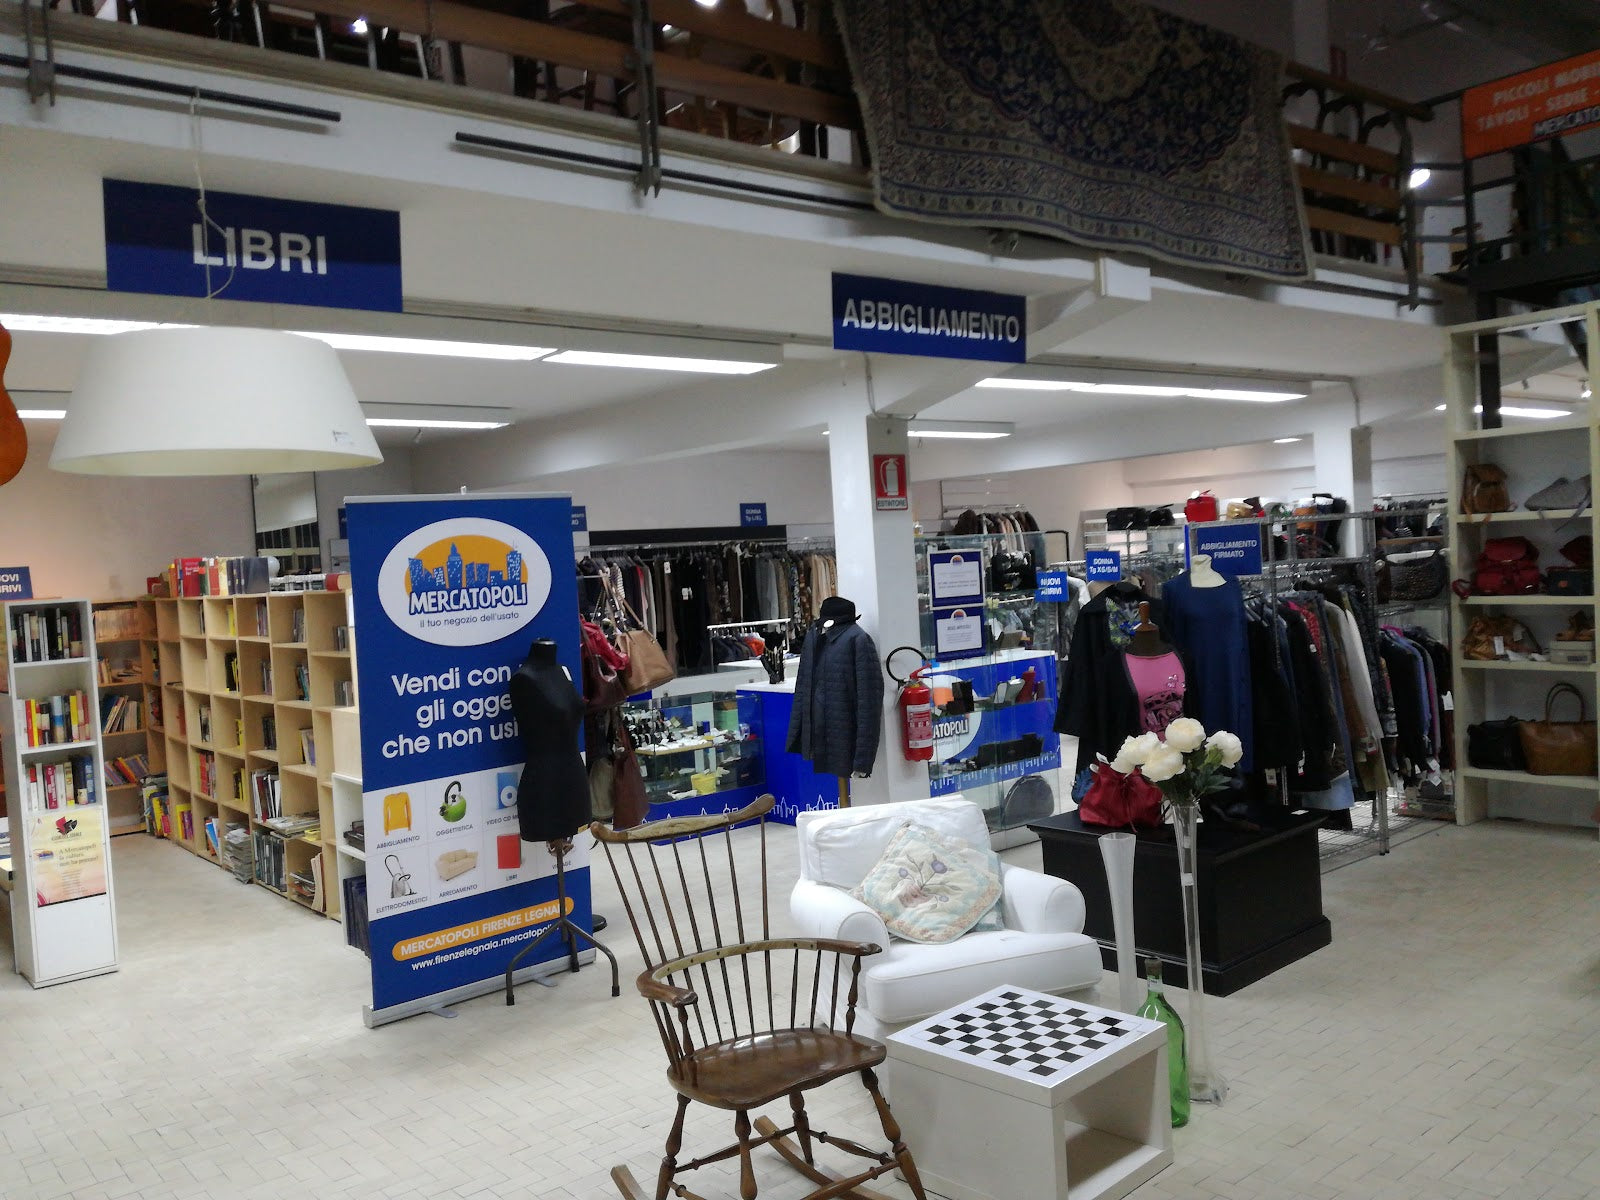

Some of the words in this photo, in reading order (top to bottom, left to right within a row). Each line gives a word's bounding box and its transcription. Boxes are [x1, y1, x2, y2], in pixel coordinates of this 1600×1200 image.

[1477, 104, 1529, 132] TAVOLI
[192, 223, 327, 275] LIBRI
[842, 298, 1020, 343] ABBIGLIAMENTO
[1201, 540, 1258, 550] ABBIGLIAMENTO
[1214, 550, 1244, 558] FIRMATO
[0, 573, 20, 583] OVI
[1041, 578, 1060, 586] NUOVI
[410, 583, 528, 615] MERCATOPOLI
[427, 618, 441, 628] tuo
[444, 615, 478, 626] negozio
[480, 611, 520, 624] dell'usato
[391, 667, 460, 696] Vendi
[467, 665, 511, 687] con
[416, 699, 445, 728] gli
[382, 734, 430, 758] che
[438, 726, 482, 749] non
[490, 717, 518, 741] usi
[487, 817, 502, 825] VIDEO
[376, 835, 420, 849] ABBIGLIAMENTO
[439, 884, 478, 898] ARREDAMENTO
[376, 896, 428, 913] ELETTRODOMESTICI
[401, 927, 479, 956] MERCATOPOLI
[482, 914, 522, 934] FIRENZE
